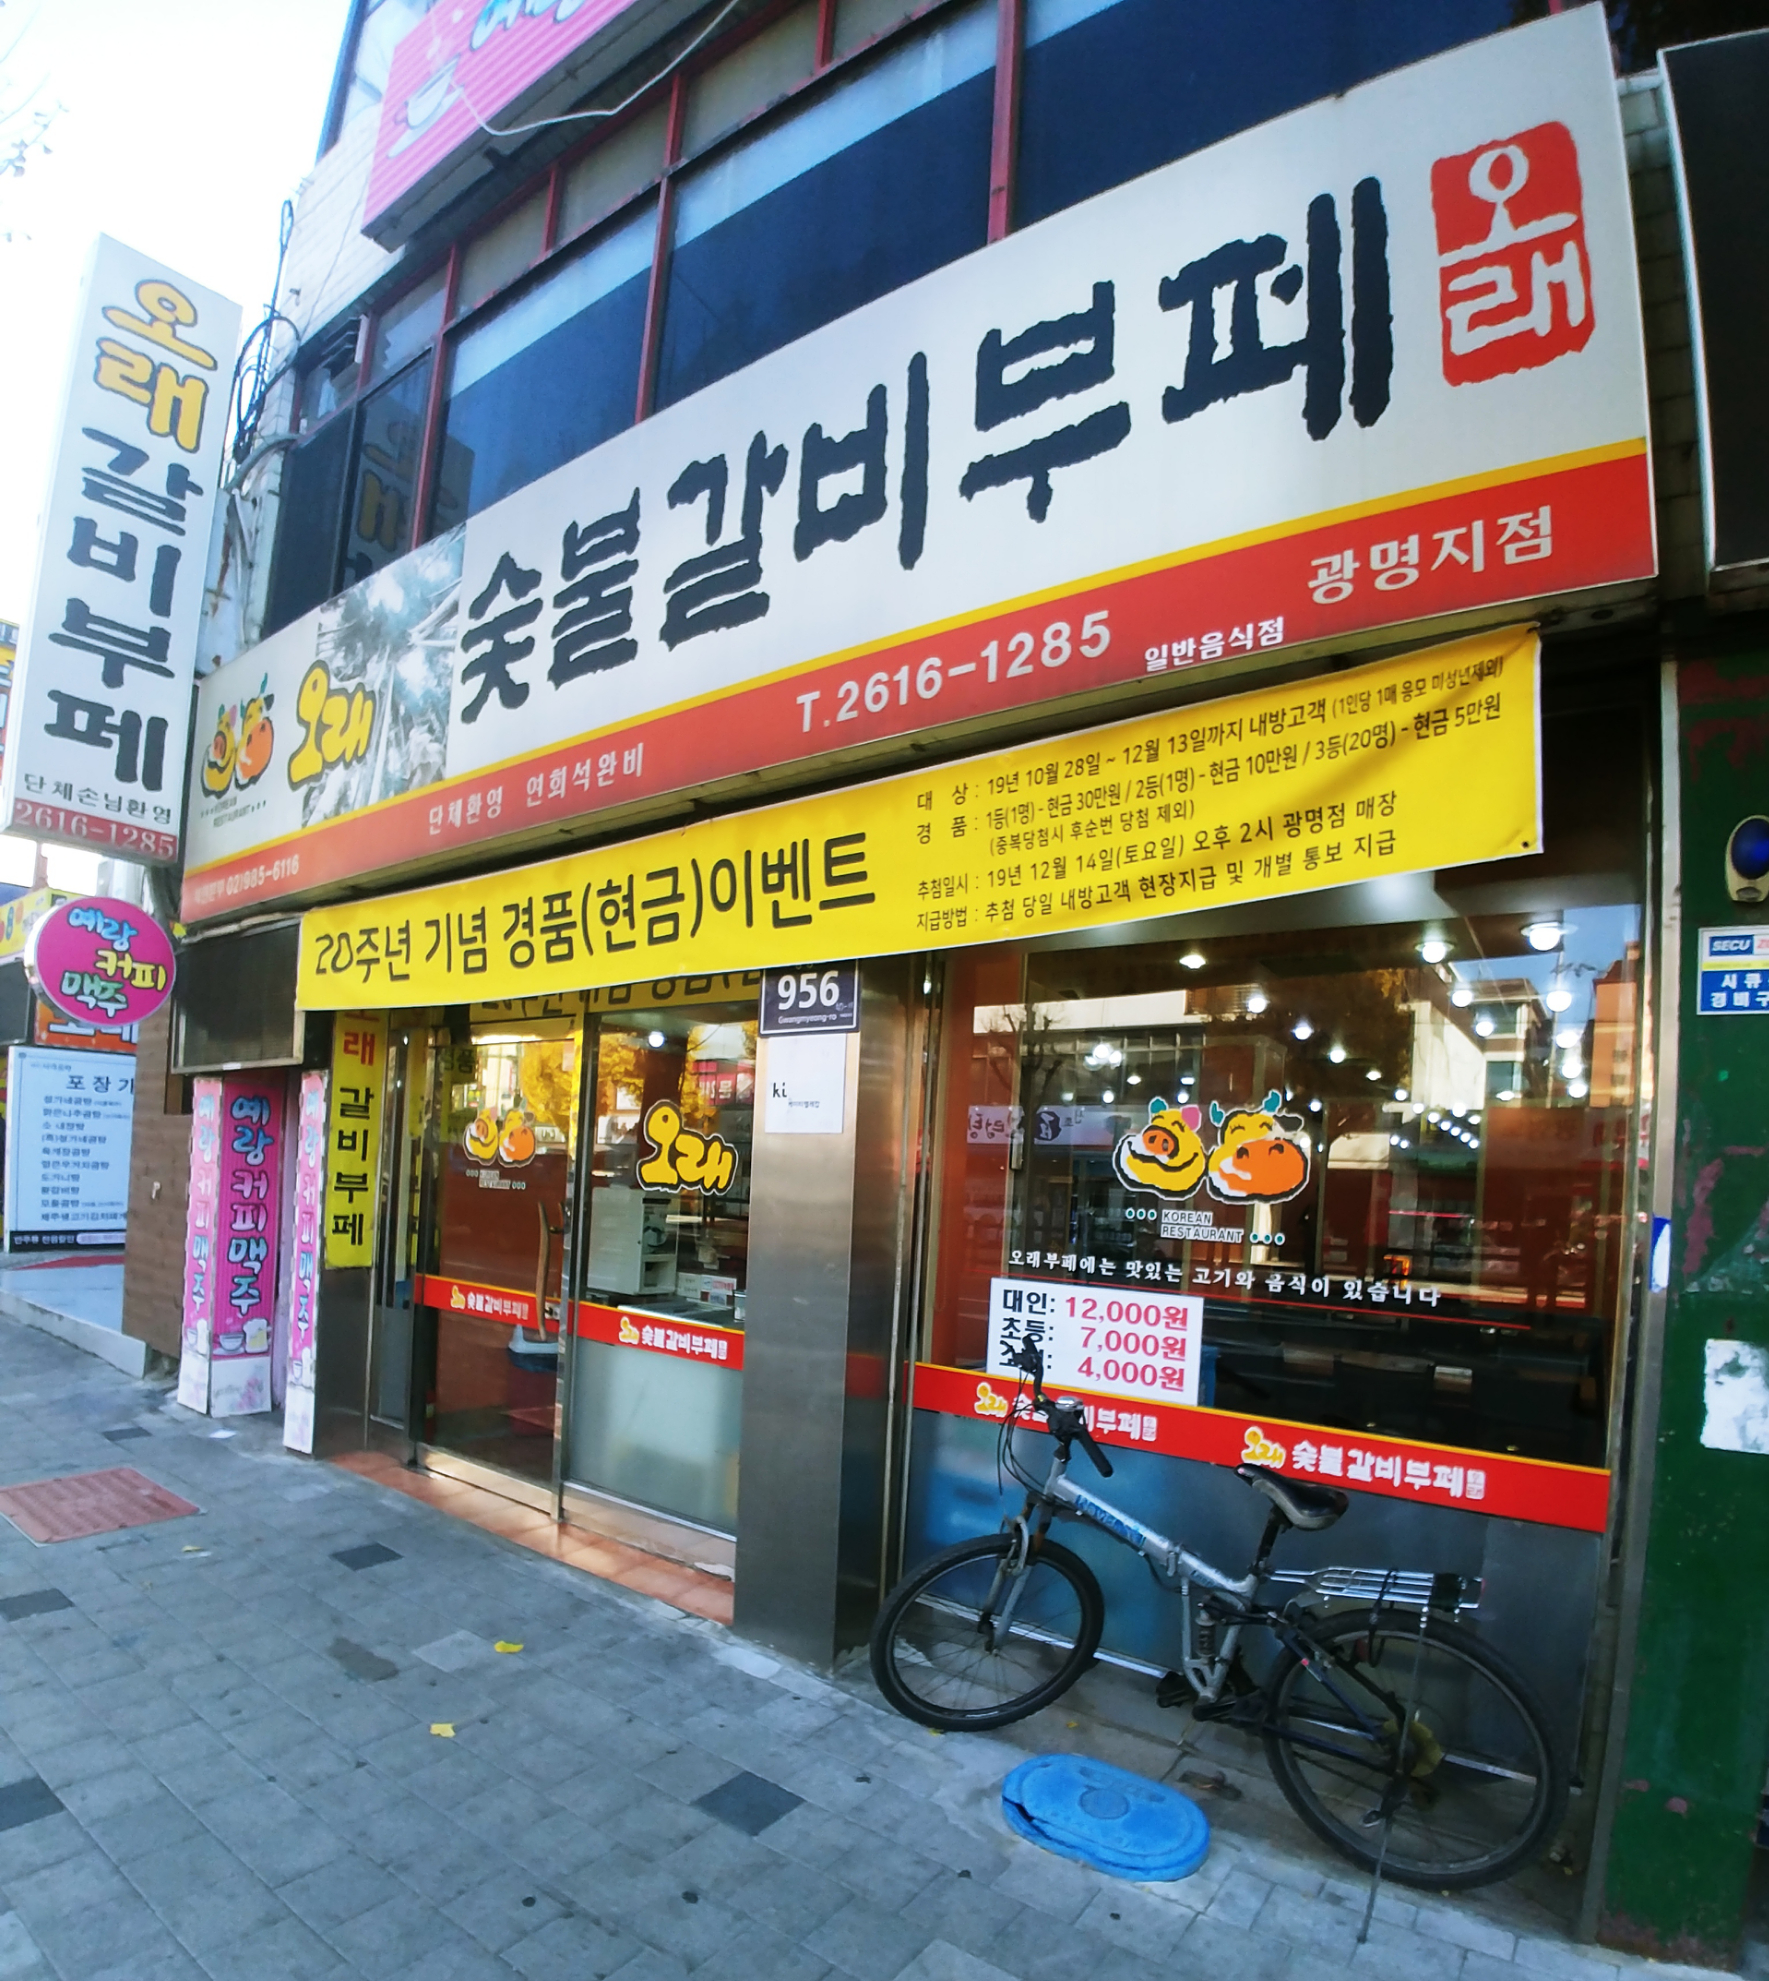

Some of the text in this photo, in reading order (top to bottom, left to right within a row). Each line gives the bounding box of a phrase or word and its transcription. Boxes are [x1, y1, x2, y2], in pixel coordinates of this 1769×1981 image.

[1438, 143, 1586, 355] 오래
[97, 278, 218, 454] 오래
[461, 177, 1394, 724] 숯불갈비부페
[1307, 506, 1554, 606] 광명지점
[797, 609, 1111, 733] T.2616-1285
[1144, 616, 1286, 673] 일반음식점
[288, 660, 378, 793] 오래
[988, 771, 1020, 796] 19년
[1026, 762, 1059, 786] 10월
[1064, 752, 1101, 778] 28일
[1123, 738, 1160, 764] 12월
[1167, 718, 1243, 757] 13일까지
[1249, 698, 1327, 737] 내방고객
[1332, 690, 1371, 719] (1인당
[1376, 683, 1398, 705] 1매
[1401, 677, 1427, 703] 응모
[986, 801, 1036, 831] 1등(1명)
[1047, 792, 1073, 819] 현금
[1077, 782, 1121, 813] 30만원
[1136, 766, 1195, 799] 2등(1명)
[1210, 757, 1241, 786] 현금
[1246, 744, 1298, 775] 10만원
[1315, 720, 1397, 760] 3등(20명)
[1413, 708, 1449, 741] 현금
[1454, 691, 1502, 727] 5만원
[24, 772, 171, 825] 단체손님환영
[429, 786, 503, 836] 단체환영
[16, 801, 174, 858] 2616-1285
[917, 872, 968, 901] 추첨일시
[988, 864, 1022, 890] 19년
[1030, 856, 1067, 881] 12월
[1075, 835, 1184, 873] 14일(토요일)
[1192, 823, 1232, 852] 오후
[1239, 816, 1274, 843] 2시
[1282, 802, 1346, 839] 광명점
[1356, 790, 1397, 820] 매장
[990, 799, 1195, 857] (중복당첨시 후순번 당첨 제외)
[314, 831, 877, 983] 20주년 기념 경품(현금)이벤트
[917, 906, 968, 932] 지급방법
[985, 899, 1015, 923] 추첨
[1022, 892, 1053, 919] 당일
[1060, 879, 1131, 911] 내방고객
[1138, 865, 1217, 901] 현장지급
[1226, 860, 1244, 884] 및
[1254, 850, 1292, 880] 개별
[1302, 842, 1343, 871] 통보
[1353, 828, 1397, 859] 지급
[67, 906, 139, 951] 예랑
[1712, 939, 1751, 951] SECU
[60, 970, 129, 1018] 맥주
[94, 949, 168, 992] 커피
[777, 970, 840, 1011] 956
[772, 1082, 787, 1098] ki
[332, 1086, 375, 1247] 갈비부페
[640, 1104, 734, 1191] 오래
[1161, 1226, 1244, 1243] RESTAURANT
[1162, 1210, 1213, 1226] KOREAN
[1003, 1289, 1189, 1331] 대인: 12,000원
[1125, 1259, 1183, 1284] 맛있는
[1193, 1267, 1256, 1291] 고기와
[1265, 1272, 1331, 1299] 음식이
[1343, 1281, 1442, 1308] 있습니다
[1080, 1327, 1187, 1362] 7,000원
[1077, 1357, 1185, 1392] 4,000원
[1241, 1426, 1286, 1469] 오래
[1292, 1440, 1464, 1498] 숯불갈비부페
